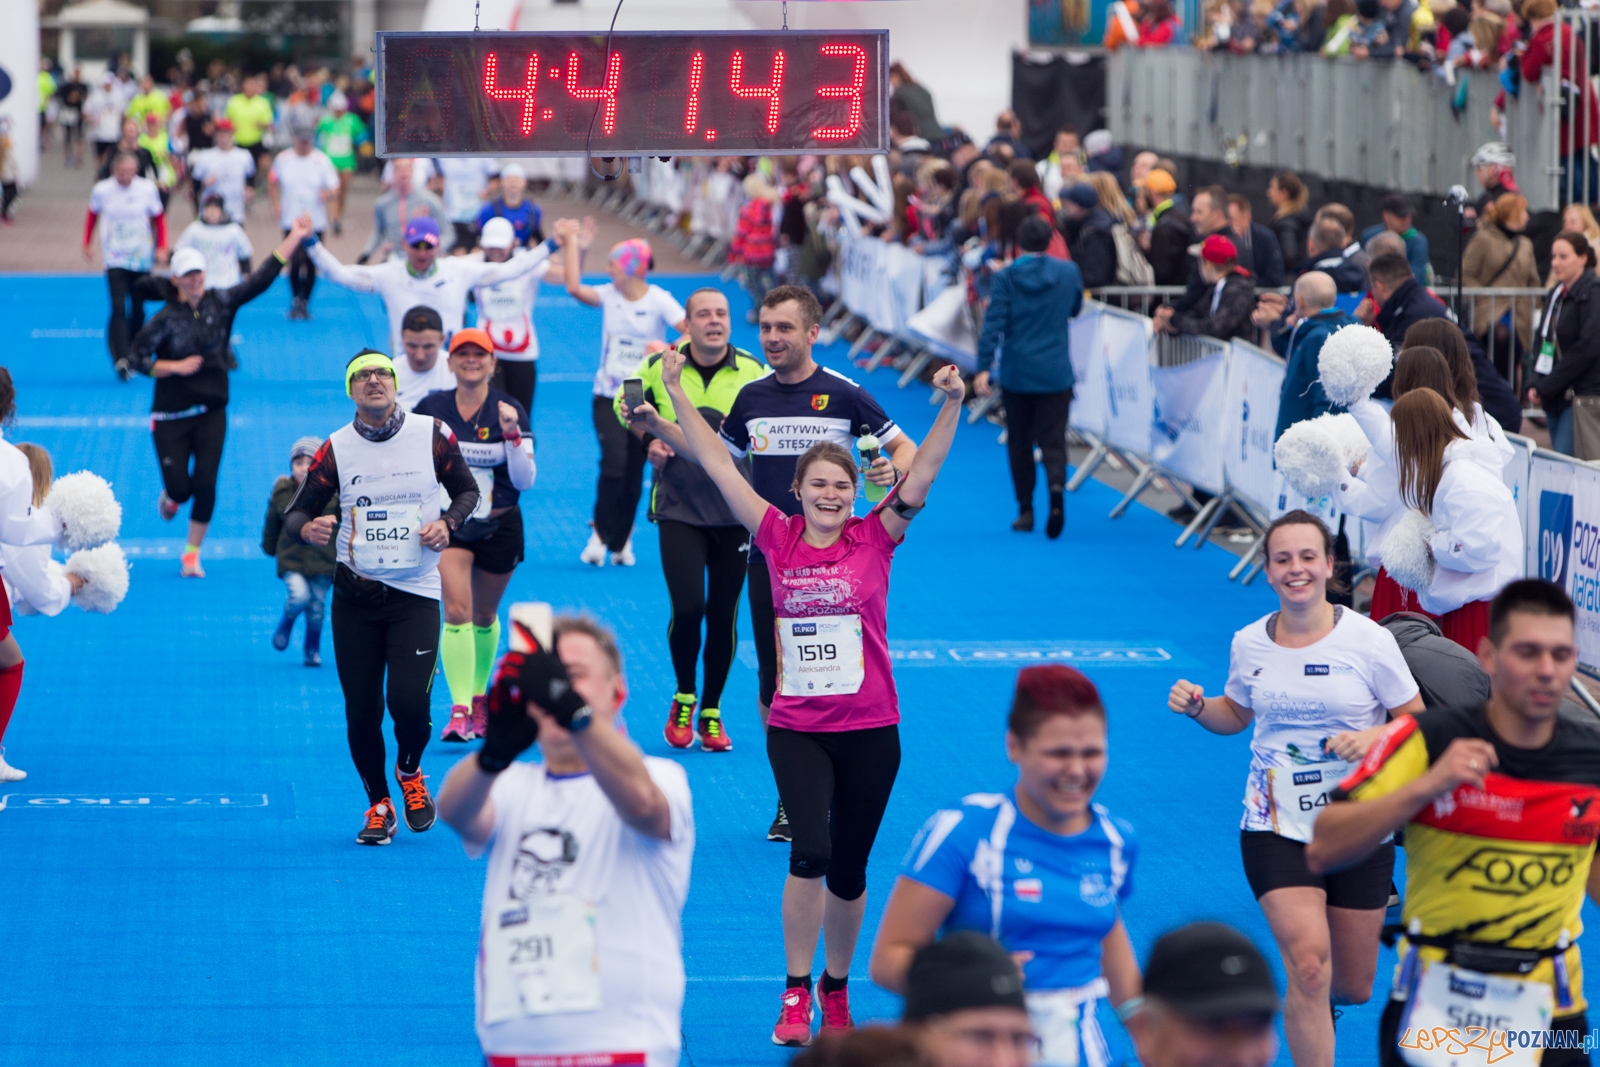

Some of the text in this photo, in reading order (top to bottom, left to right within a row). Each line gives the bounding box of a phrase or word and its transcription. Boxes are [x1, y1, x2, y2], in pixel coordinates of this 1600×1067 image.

[769, 424, 829, 435] AKTYWNY
[778, 439, 833, 451] STĘSZE
[365, 527, 410, 541] 6642
[797, 643, 837, 661] 1519
[798, 665, 841, 673] Aleksandra
[1270, 701, 1327, 712] ODWAGA
[1299, 792, 1331, 811] 64
[509, 934, 554, 965] 291
